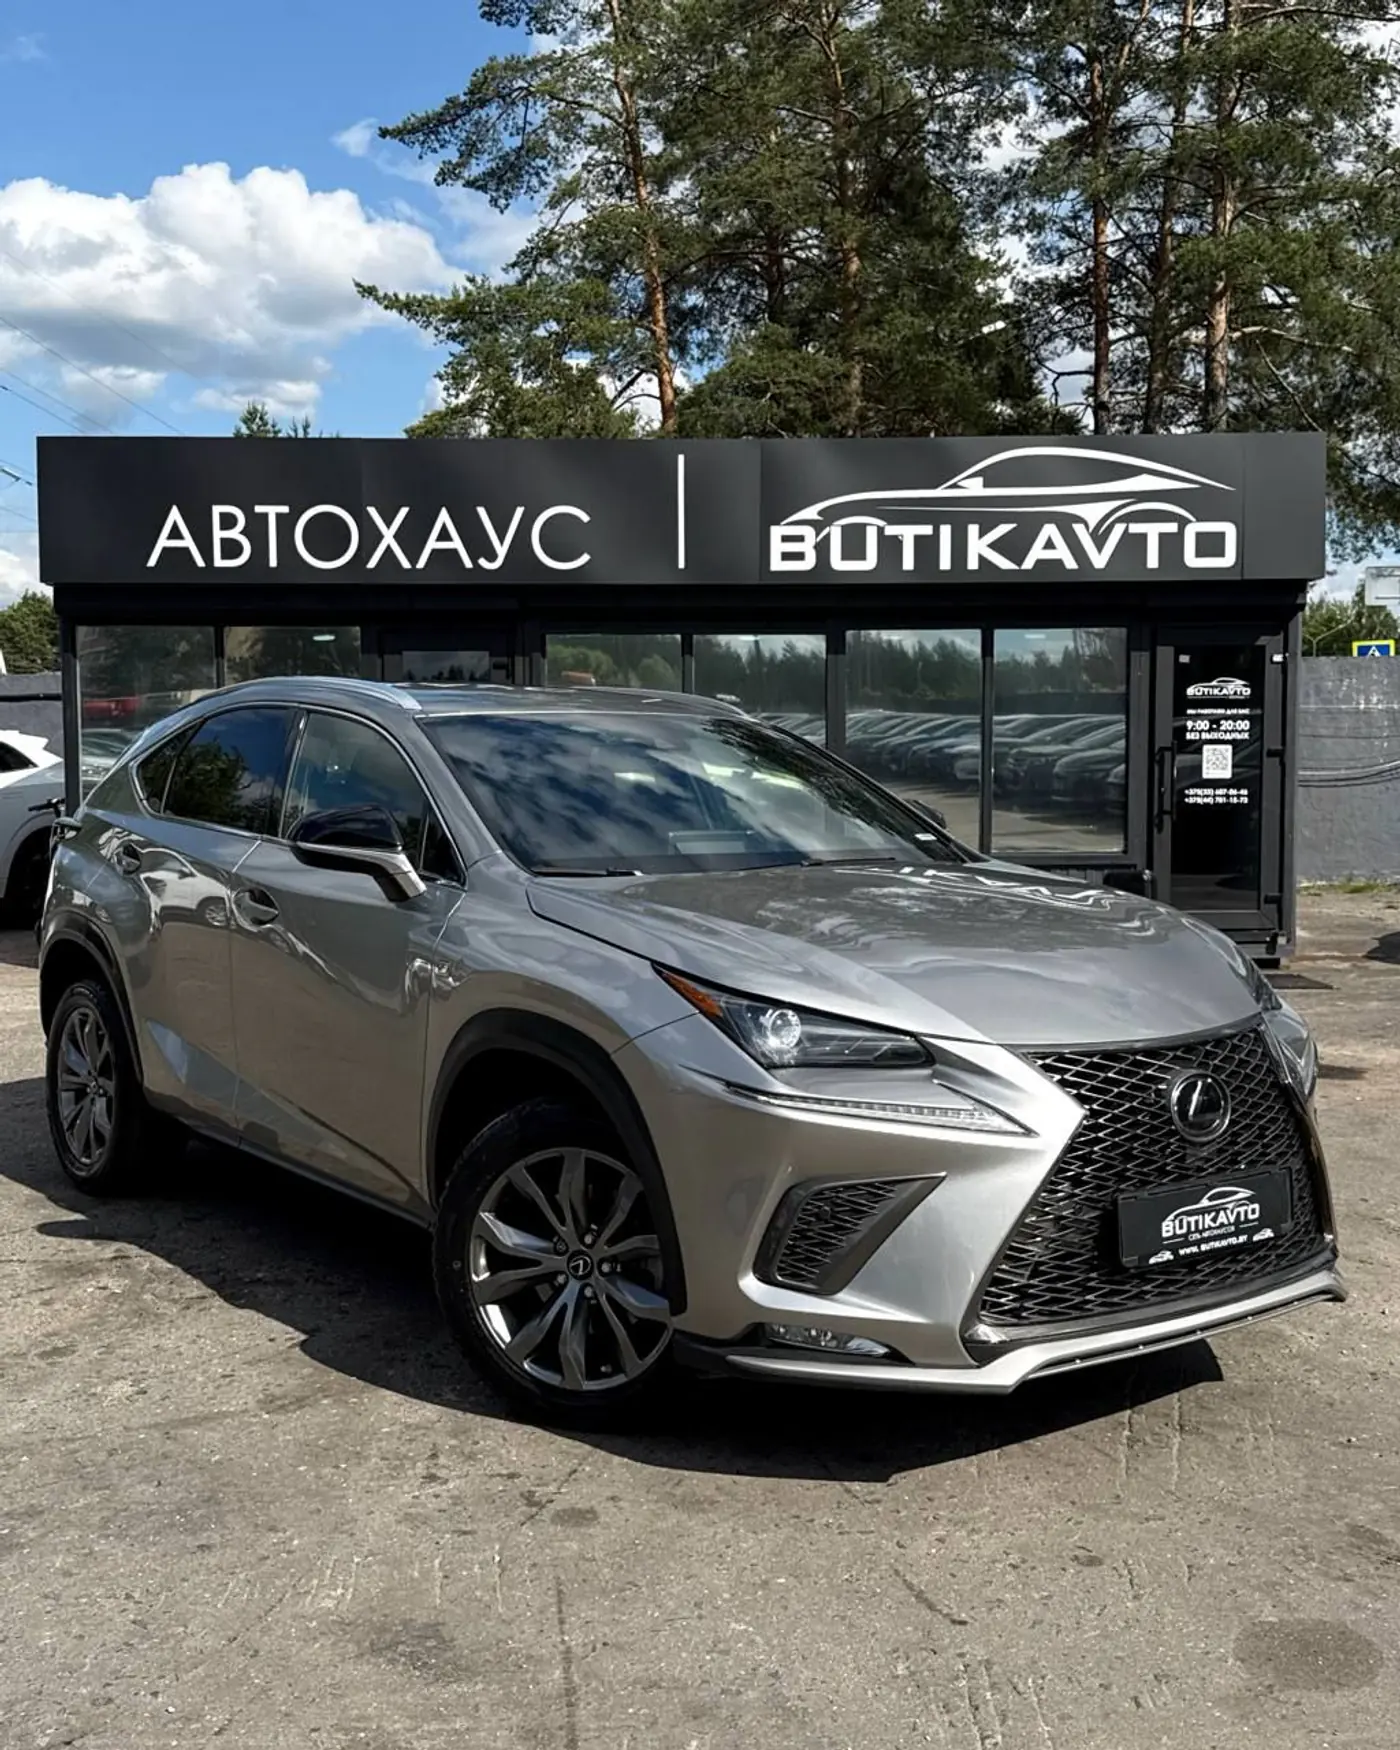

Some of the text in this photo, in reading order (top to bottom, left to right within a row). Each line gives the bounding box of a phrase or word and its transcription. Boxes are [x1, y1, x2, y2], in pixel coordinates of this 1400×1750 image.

[147, 505, 591, 569] АВТОХАУС
[770, 521, 1237, 571] BUTIKAVTO
[1186, 687, 1251, 696] BUTIKAVTO
[1186, 720, 1210, 731] 9:00
[1219, 720, 1250, 731] 20:00
[1186, 731, 1250, 740] БЕЗ ВЫХОДНЫХ
[1162, 1203, 1260, 1238] BUTIKAVTO
